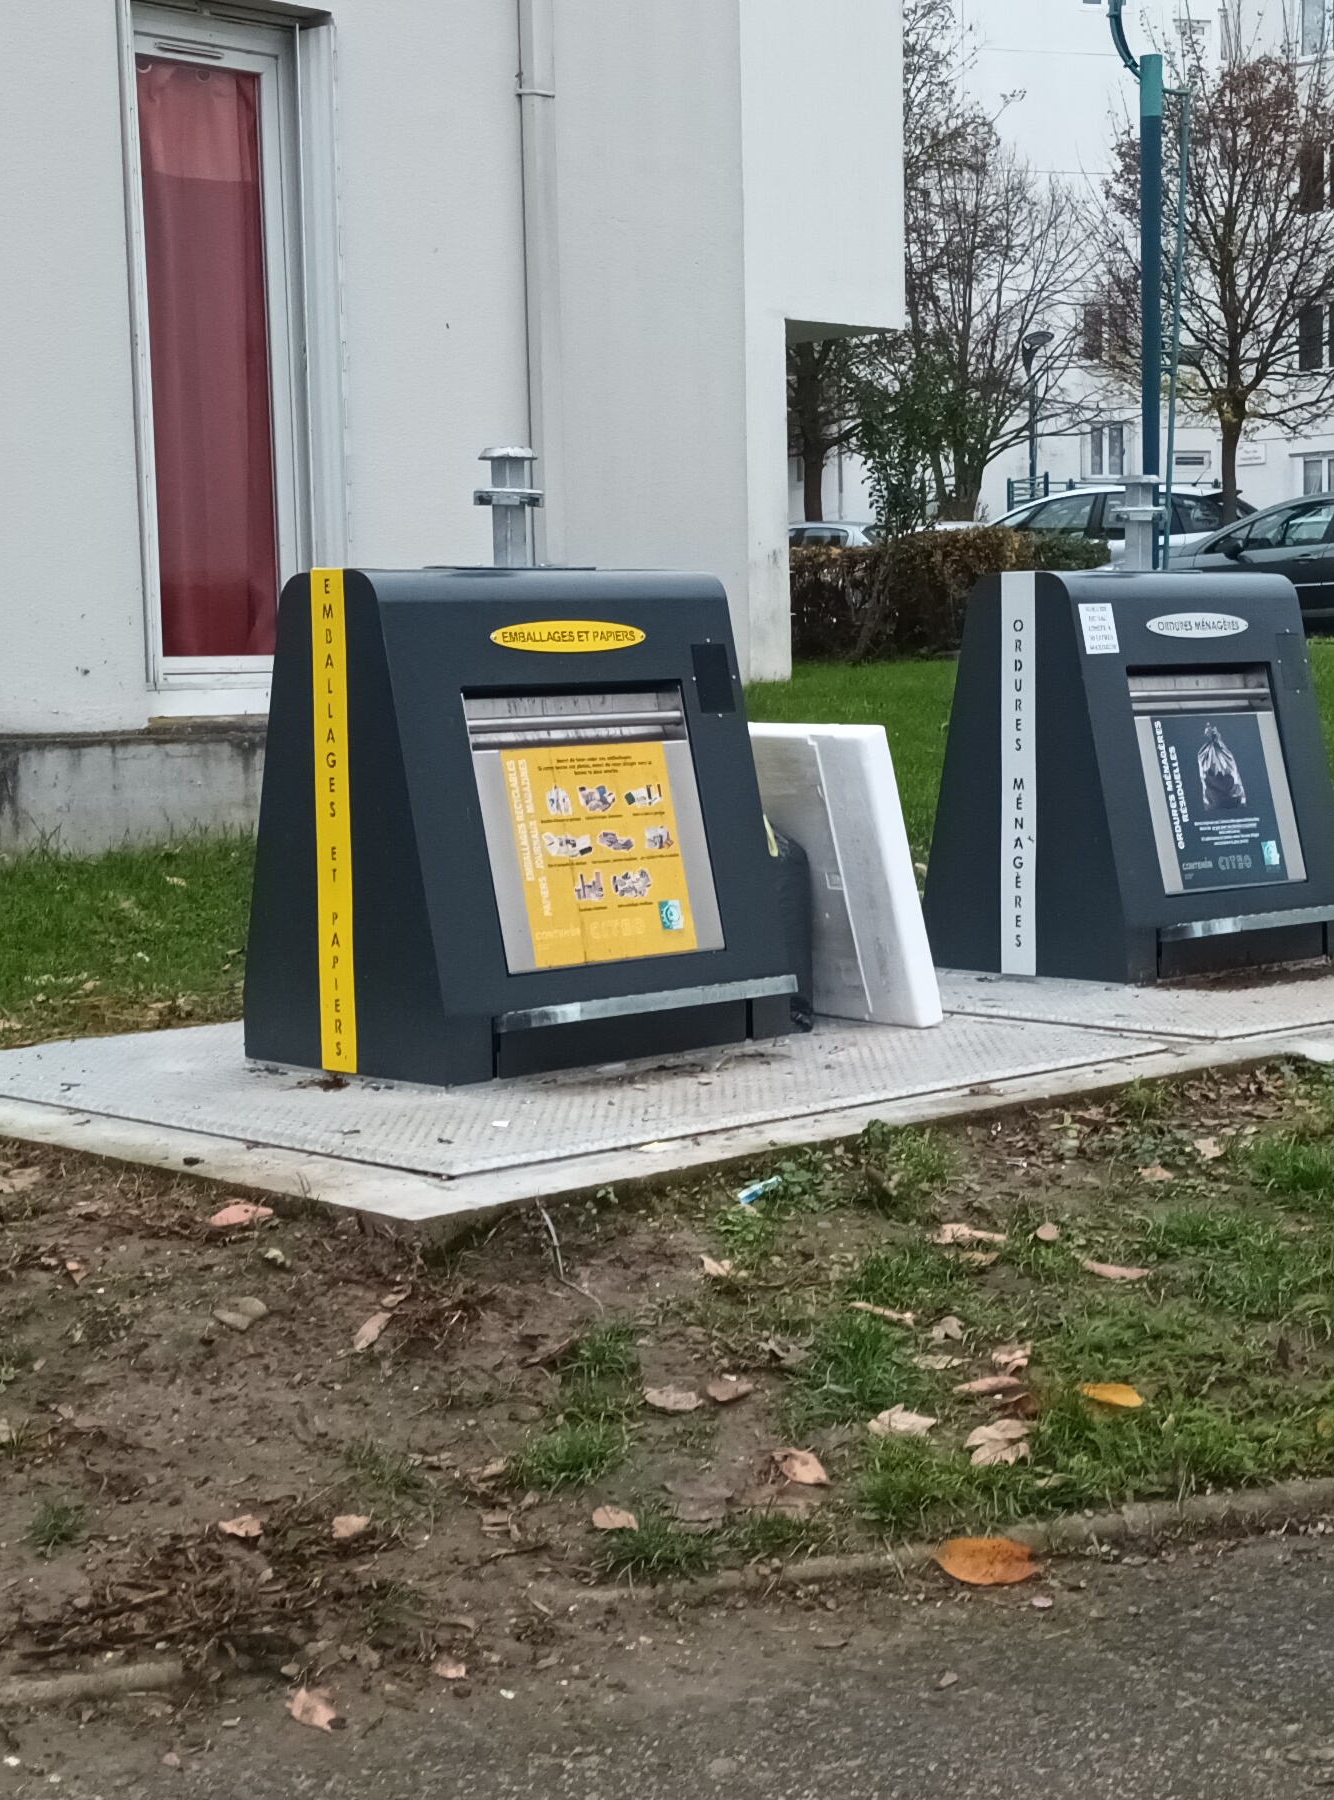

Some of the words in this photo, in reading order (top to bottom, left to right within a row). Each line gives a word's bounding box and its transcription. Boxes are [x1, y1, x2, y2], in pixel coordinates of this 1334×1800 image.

[502, 630, 575, 643] EMBALLAGES
[578, 630, 590, 642] ET
[592, 630, 636, 642] PAPIERS
[1157, 620, 1193, 631] ORDURES
[1194, 618, 1240, 631] MÉNAGÈRES
[322, 578, 337, 818] EMBALLAGES
[1012, 619, 1024, 752] ORDURES
[518, 758, 535, 814] MAGAZINES
[1154, 720, 1174, 792] MÉNAGÈRES
[1168, 745, 1189, 823] RÉSIDUELLES
[506, 759, 525, 822] RECYCLABLES
[529, 820, 545, 870] JOURNAUX
[1168, 794, 1185, 849] ORDURES
[330, 846, 338, 883] ET
[517, 822, 535, 882] EMBALLAGES
[1012, 777, 1026, 948] MÉNAGÈRES
[589, 917, 646, 940] CITEO
[330, 911, 343, 1057] PAPIERS
